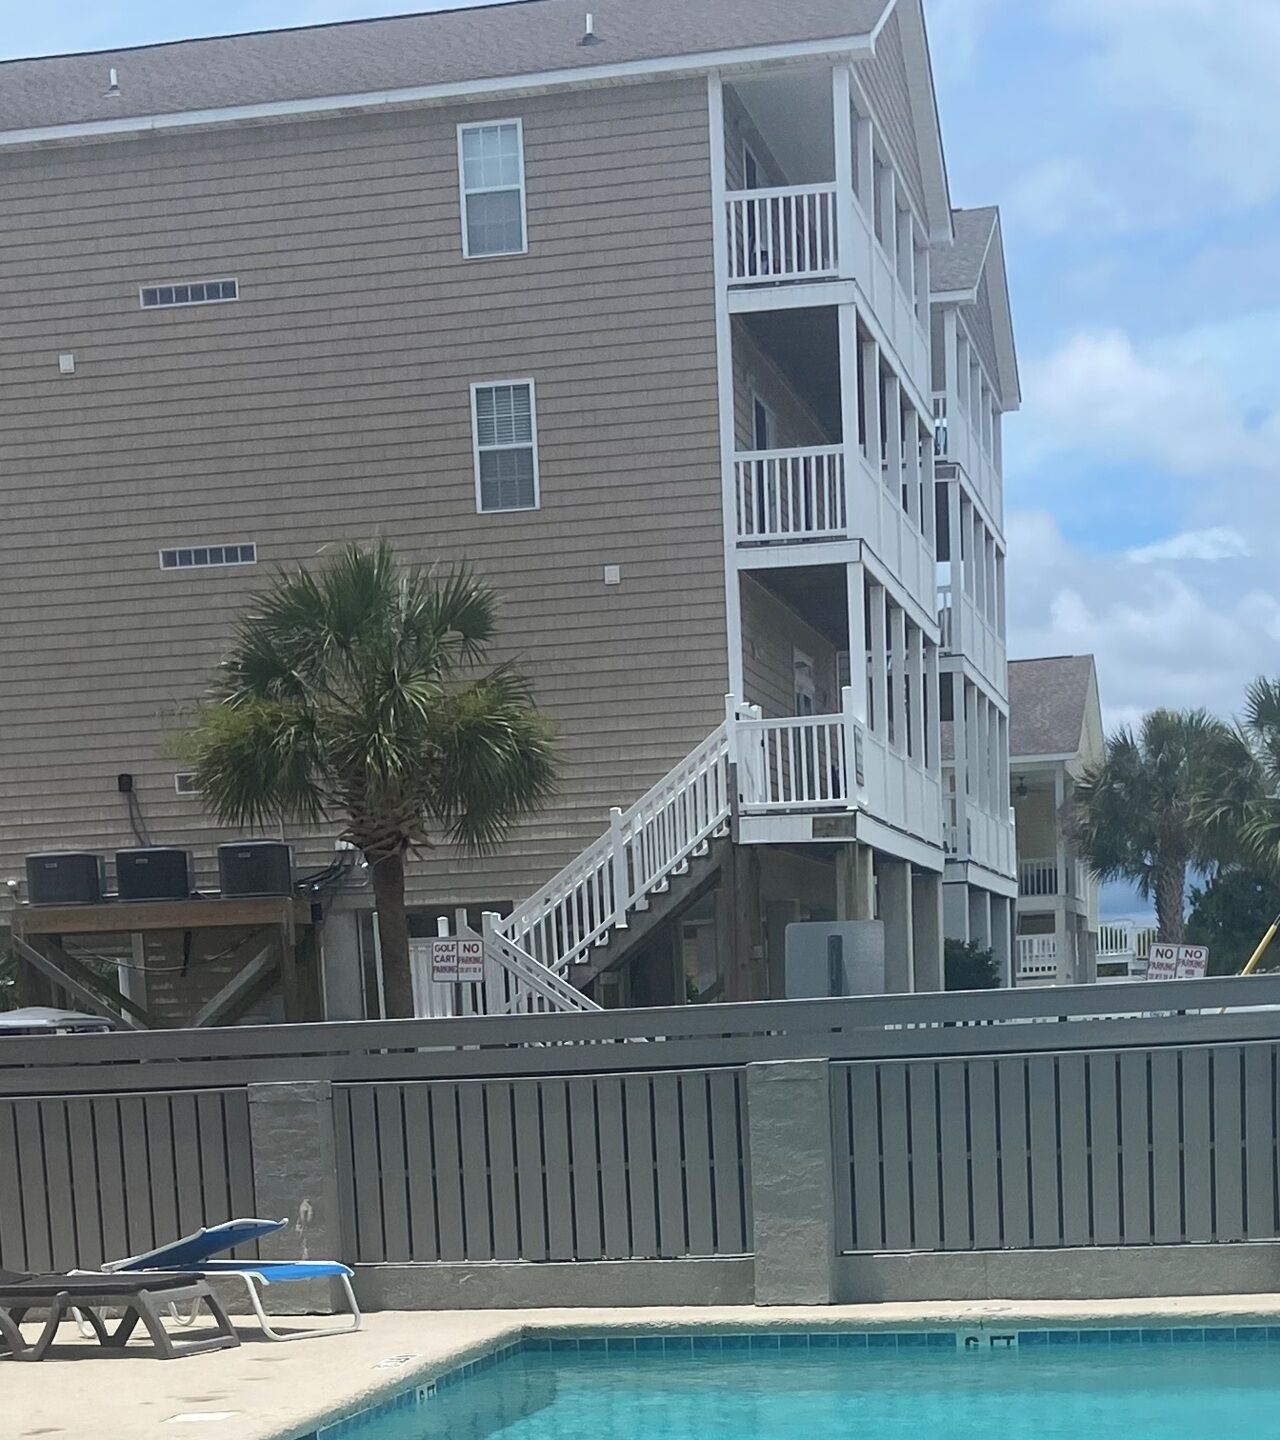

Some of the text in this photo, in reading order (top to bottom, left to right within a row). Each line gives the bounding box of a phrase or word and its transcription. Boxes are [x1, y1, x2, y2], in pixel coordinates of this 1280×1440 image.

[435, 944, 456, 952] GOLF
[463, 943, 479, 953] NO
[1156, 948, 1173, 959] NO
[1185, 949, 1202, 959] NO
[434, 955, 456, 963] CART
